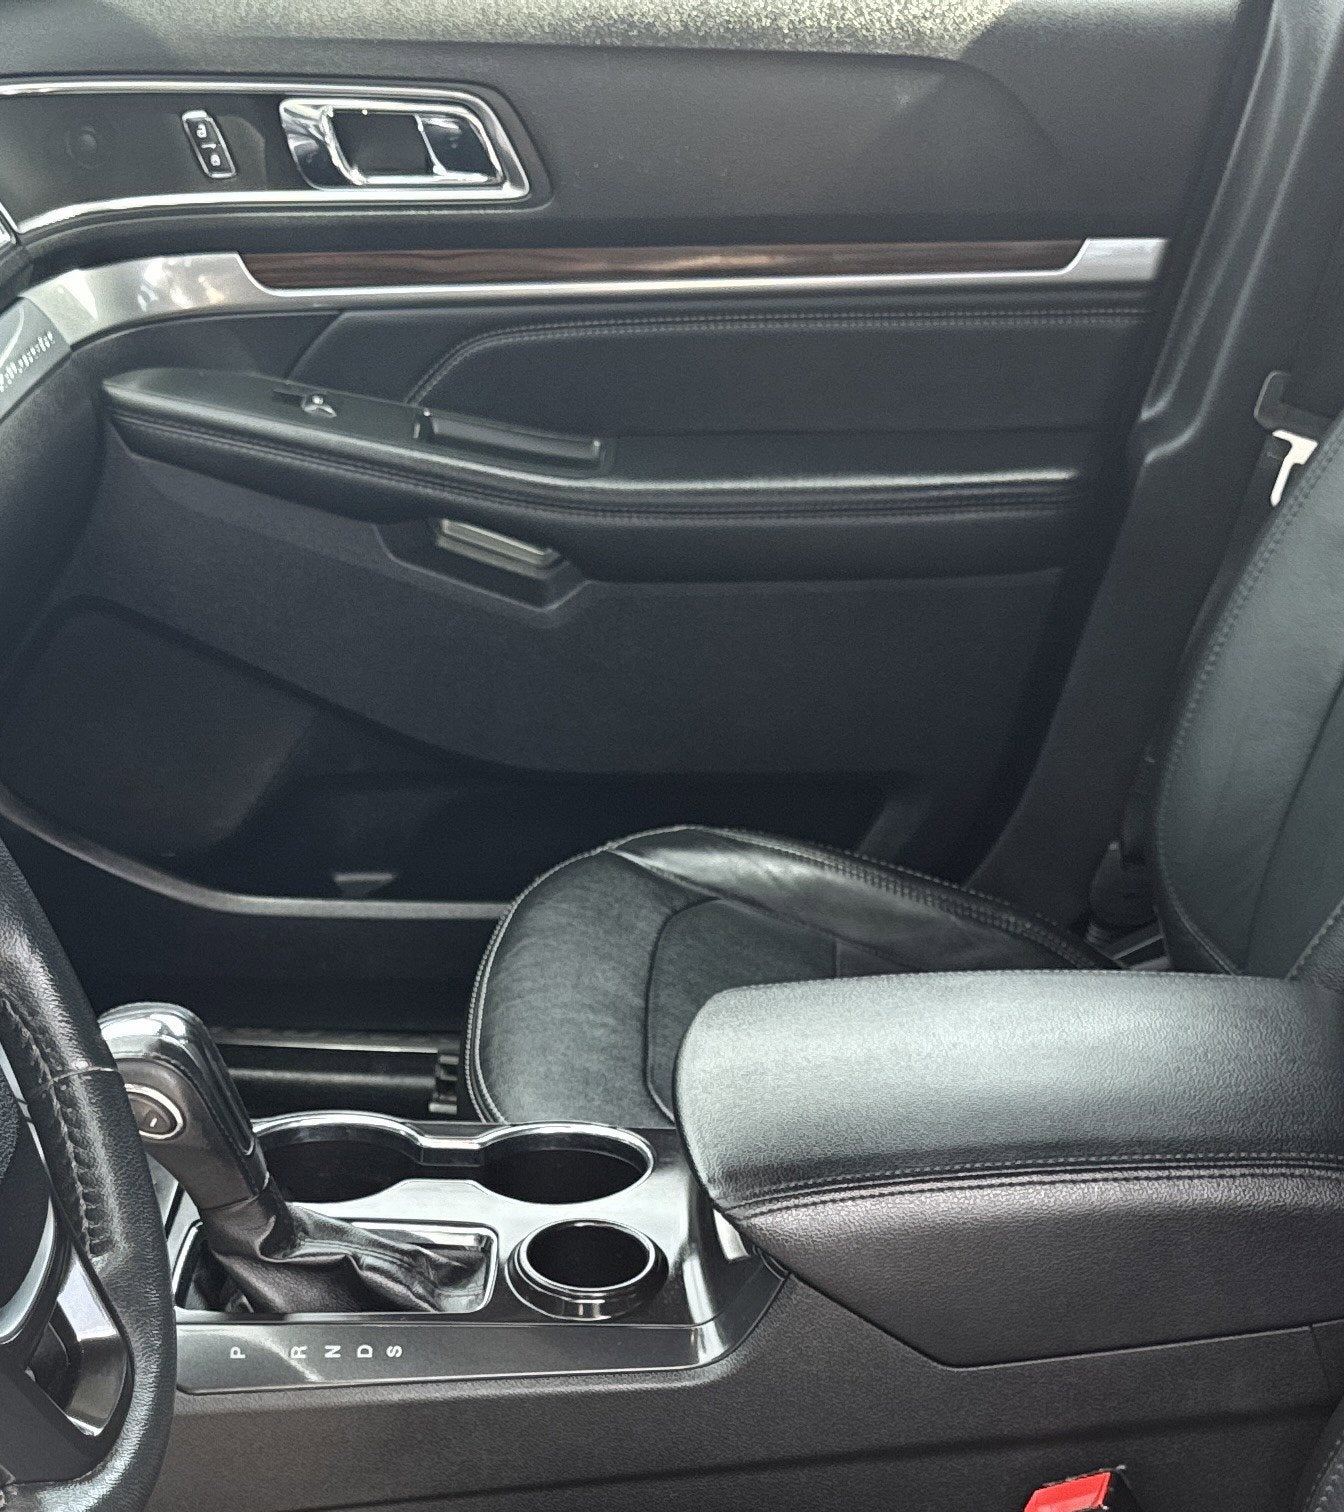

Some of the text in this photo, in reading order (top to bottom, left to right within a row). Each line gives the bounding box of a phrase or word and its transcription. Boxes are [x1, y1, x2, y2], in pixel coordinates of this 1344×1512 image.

[231, 1344, 404, 1359] P R N D S
